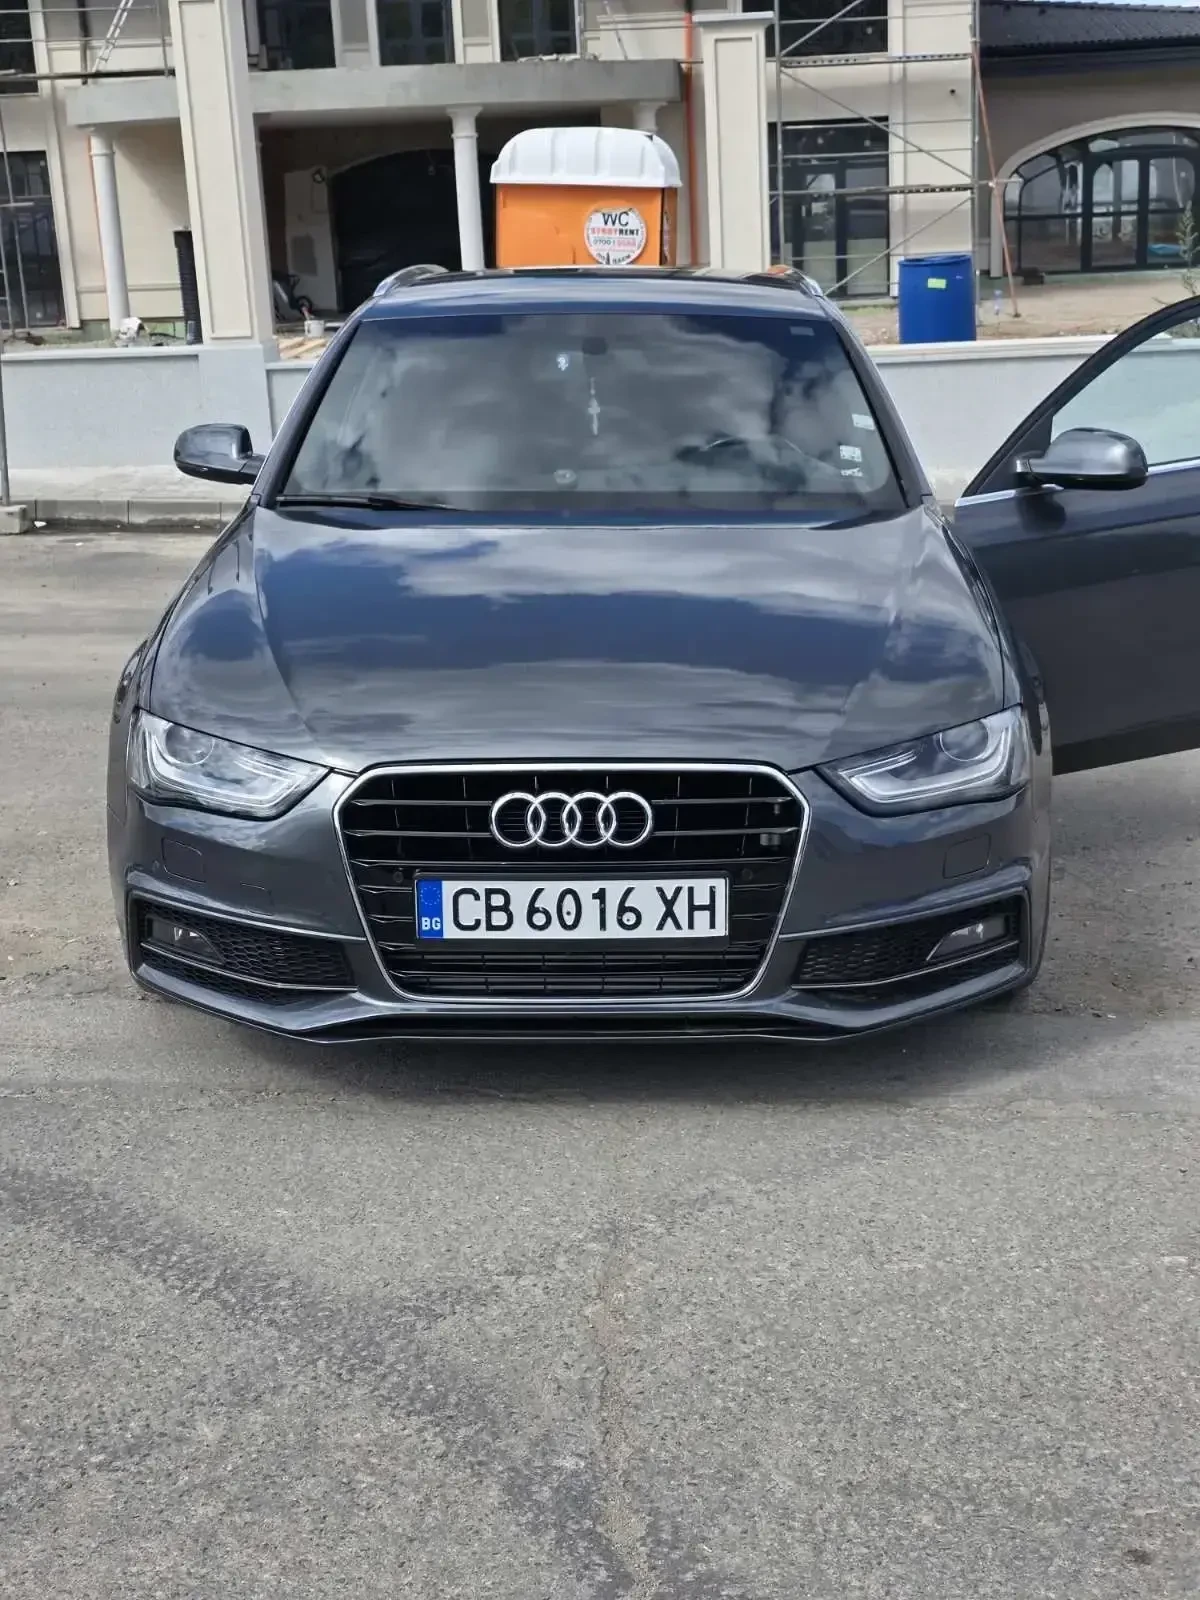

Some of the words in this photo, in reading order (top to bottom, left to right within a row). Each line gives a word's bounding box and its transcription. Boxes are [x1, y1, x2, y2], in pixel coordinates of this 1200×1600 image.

[602, 211, 629, 226] WC
[452, 887, 514, 932] CB
[526, 886, 643, 932] 6016
[655, 885, 717, 931] XH
[421, 916, 441, 931] BG
